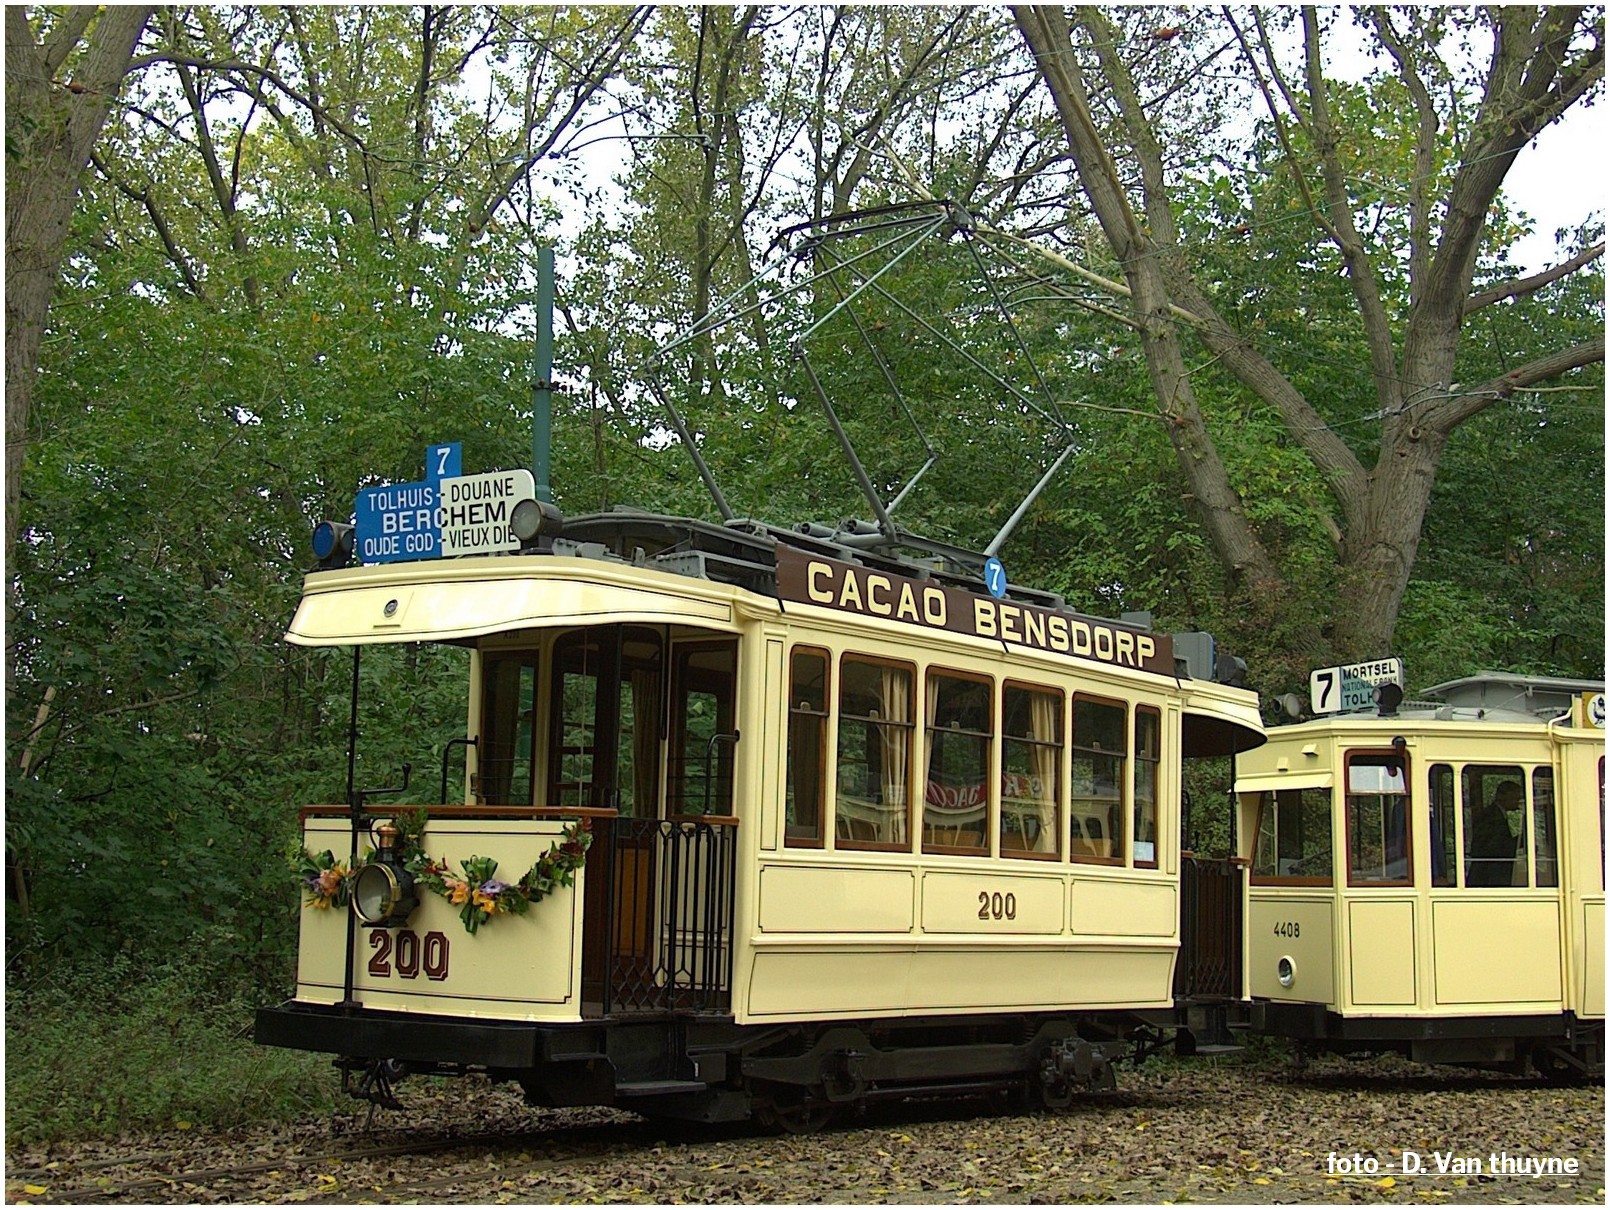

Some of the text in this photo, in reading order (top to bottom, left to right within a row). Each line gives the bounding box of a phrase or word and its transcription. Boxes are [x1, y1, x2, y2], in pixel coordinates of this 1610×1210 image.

[437, 448, 450, 475] 7
[368, 487, 433, 512] TOLHUIS
[451, 477, 514, 503] DOUANE
[383, 501, 506, 534] BERCHEM
[365, 536, 400, 557] OUDE
[406, 533, 434, 553] GOD
[449, 526, 490, 549] VIEUX
[493, 525, 517, 545] DIE
[990, 563, 1001, 591] 7
[807, 561, 1156, 668] CACAO BENSDORP
[1343, 662, 1396, 681] MORTSEL
[1317, 672, 1333, 708] 7
[1344, 690, 1374, 706] TOLH
[978, 891, 1017, 920] 200
[1273, 921, 1300, 938] 4408
[368, 929, 450, 981] 200
